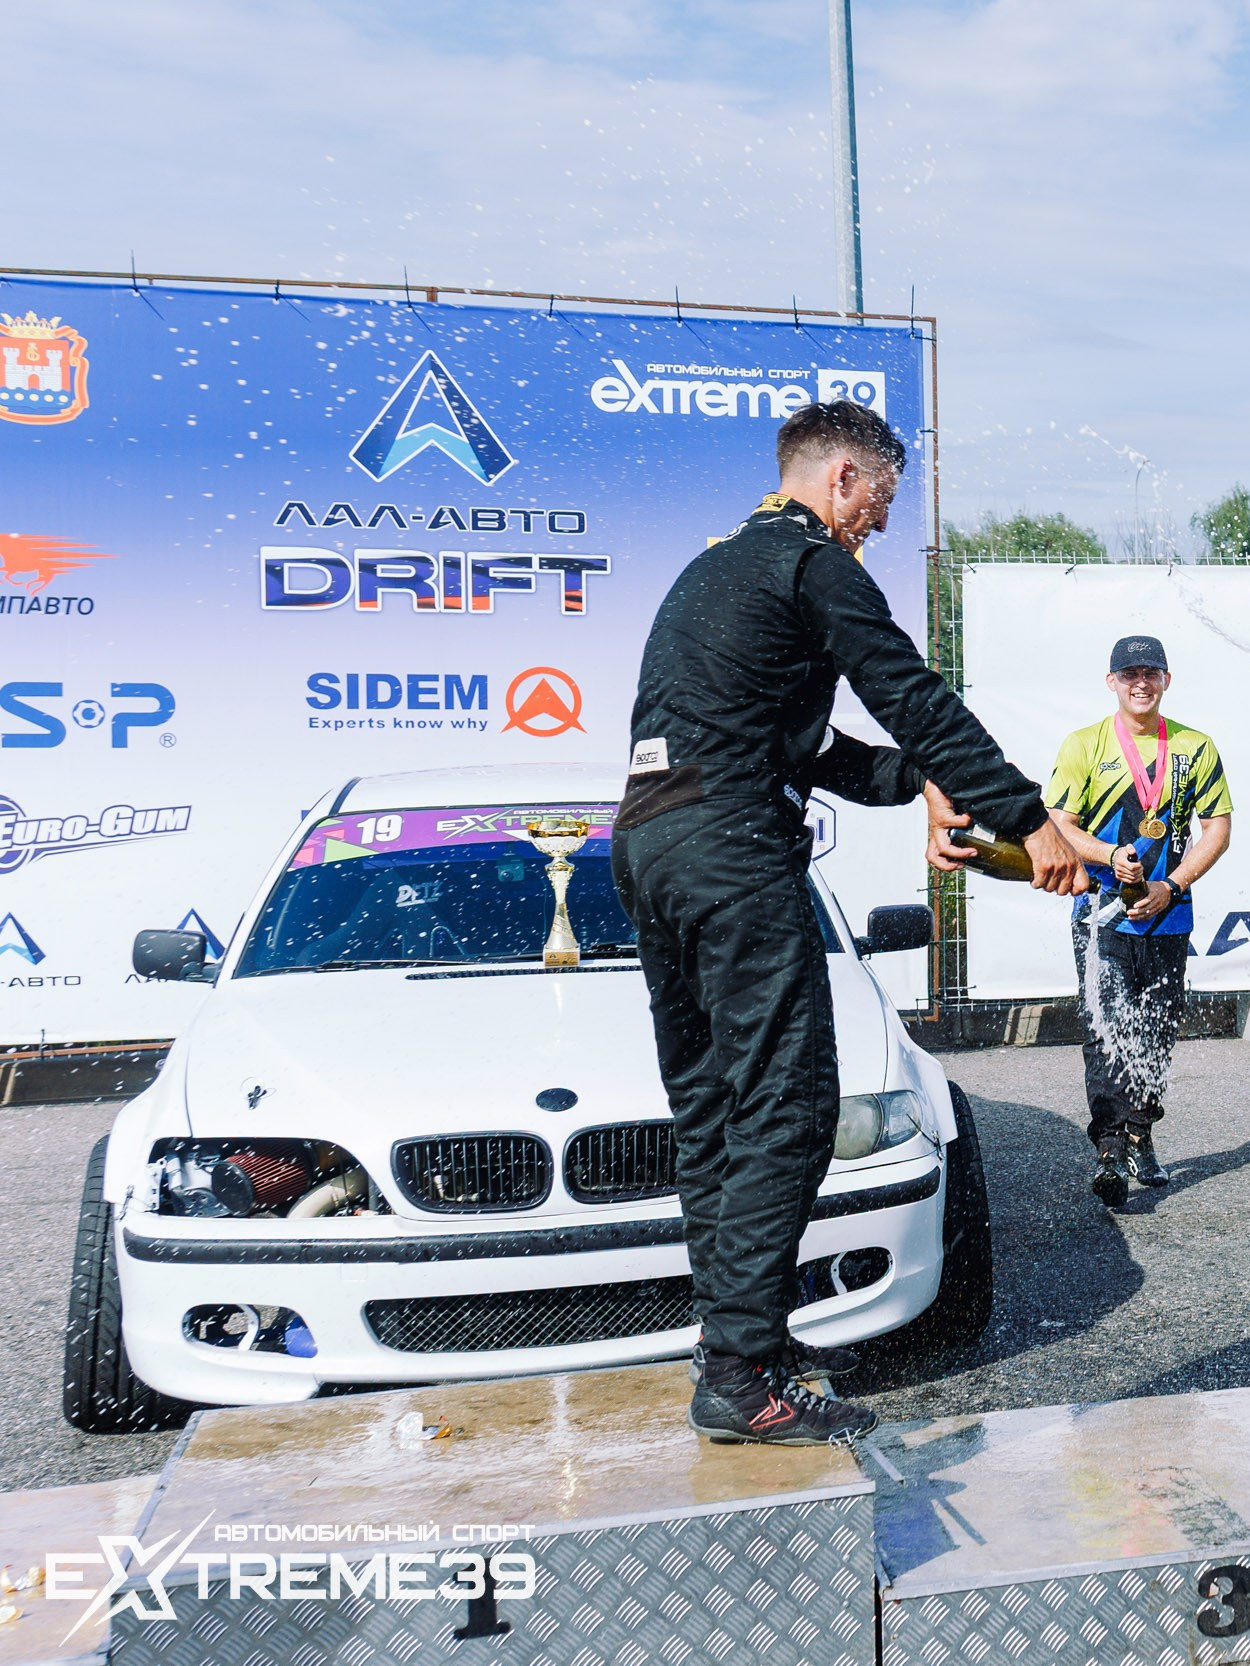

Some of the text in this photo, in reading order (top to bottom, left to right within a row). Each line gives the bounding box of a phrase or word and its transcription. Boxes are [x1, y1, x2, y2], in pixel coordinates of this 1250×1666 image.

[647, 363, 811, 380] АВТОМОБИЛЬНЫЙ СПОРТ
[273, 501, 588, 535] ЛАЛ-АВТО
[260, 546, 612, 616] DRIFT
[306, 672, 489, 710] SIDEM
[308, 716, 489, 732] Experts know why
[356, 814, 403, 845] 19
